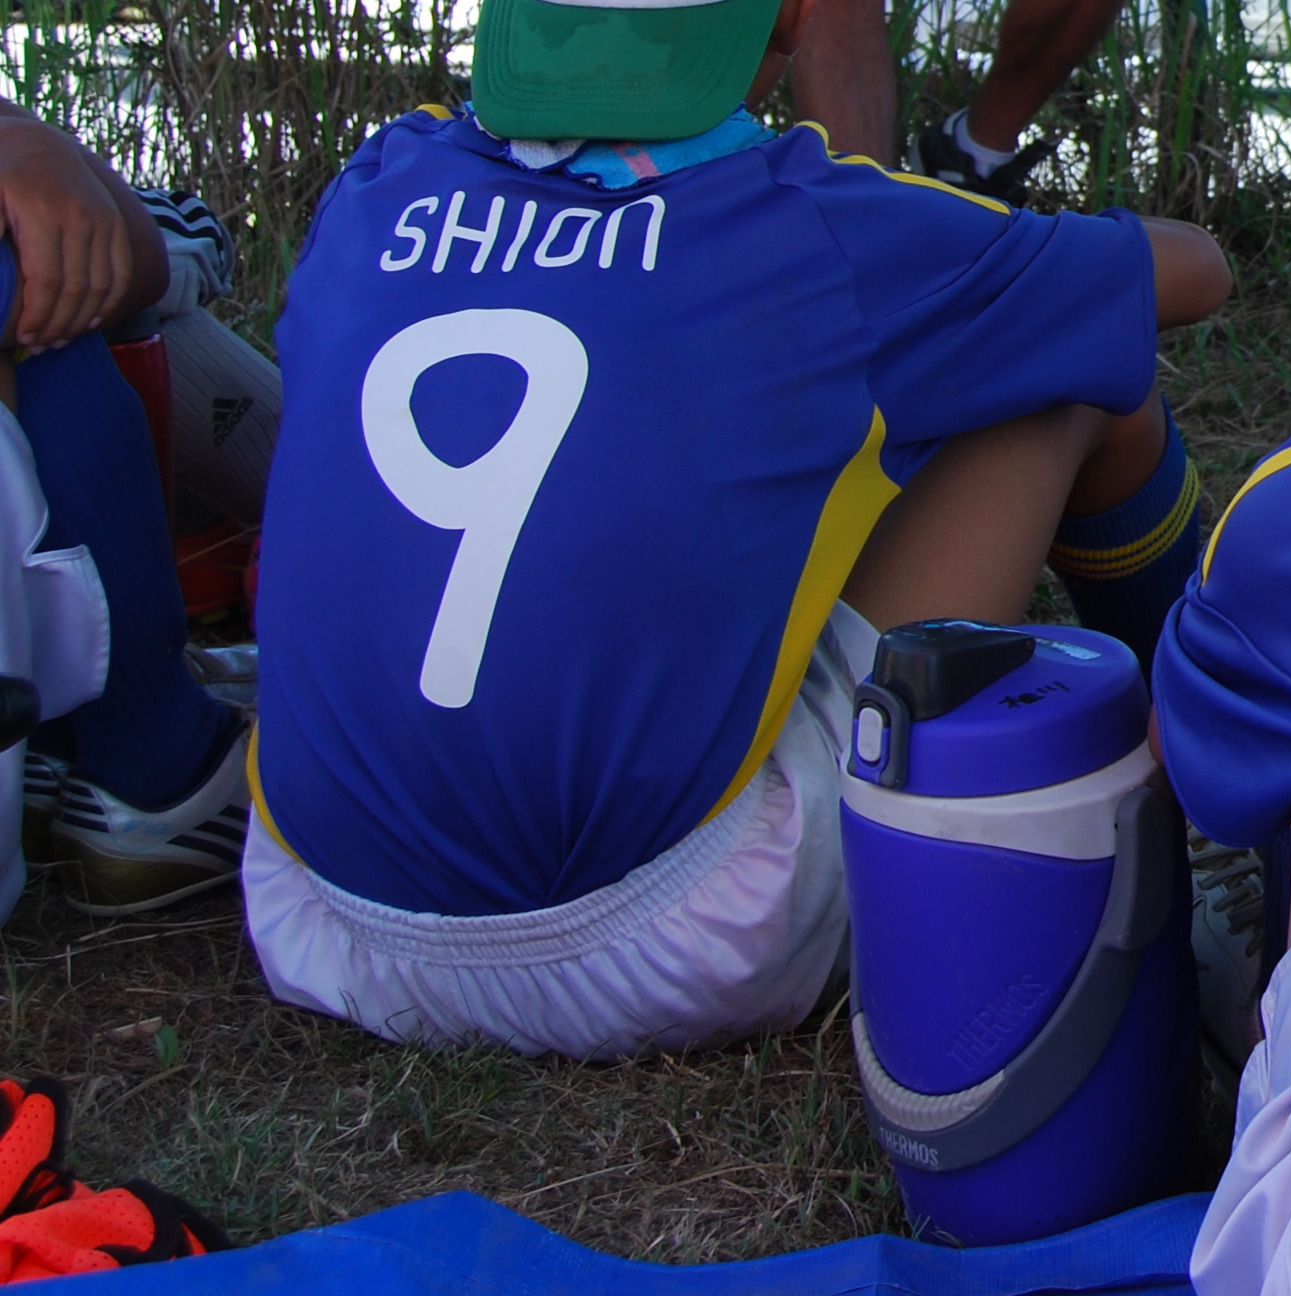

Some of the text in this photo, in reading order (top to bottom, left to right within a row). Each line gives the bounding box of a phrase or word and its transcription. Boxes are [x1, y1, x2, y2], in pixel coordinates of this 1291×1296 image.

[379, 190, 666, 275] SHION
[361, 308, 588, 709] 9
[946, 974, 1048, 1072] THERMOS
[879, 1126, 939, 1167] THERMOS
